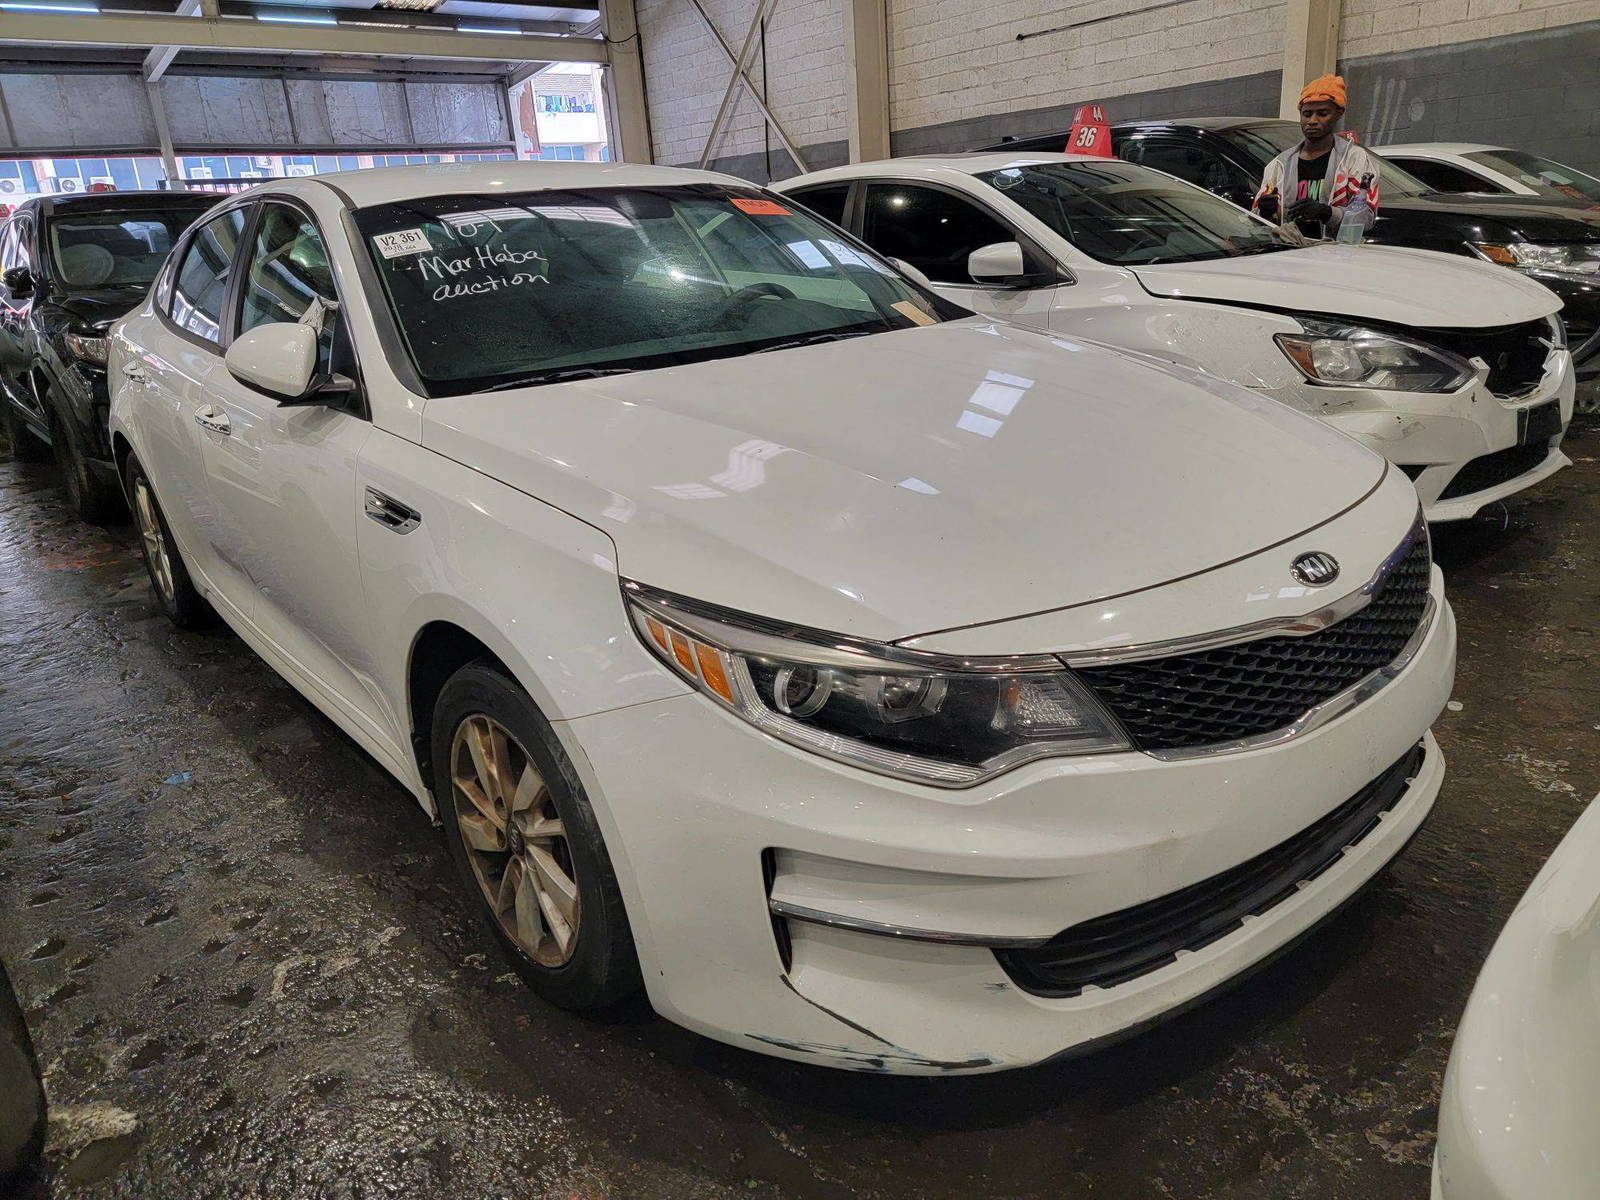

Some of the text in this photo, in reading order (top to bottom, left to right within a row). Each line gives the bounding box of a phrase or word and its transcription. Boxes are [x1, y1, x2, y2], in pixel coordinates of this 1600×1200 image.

[1076, 126, 1098, 148] 36
[380, 231, 422, 247] V2 361
[432, 273, 550, 301] auction
[1296, 553, 1338, 581] KIA
